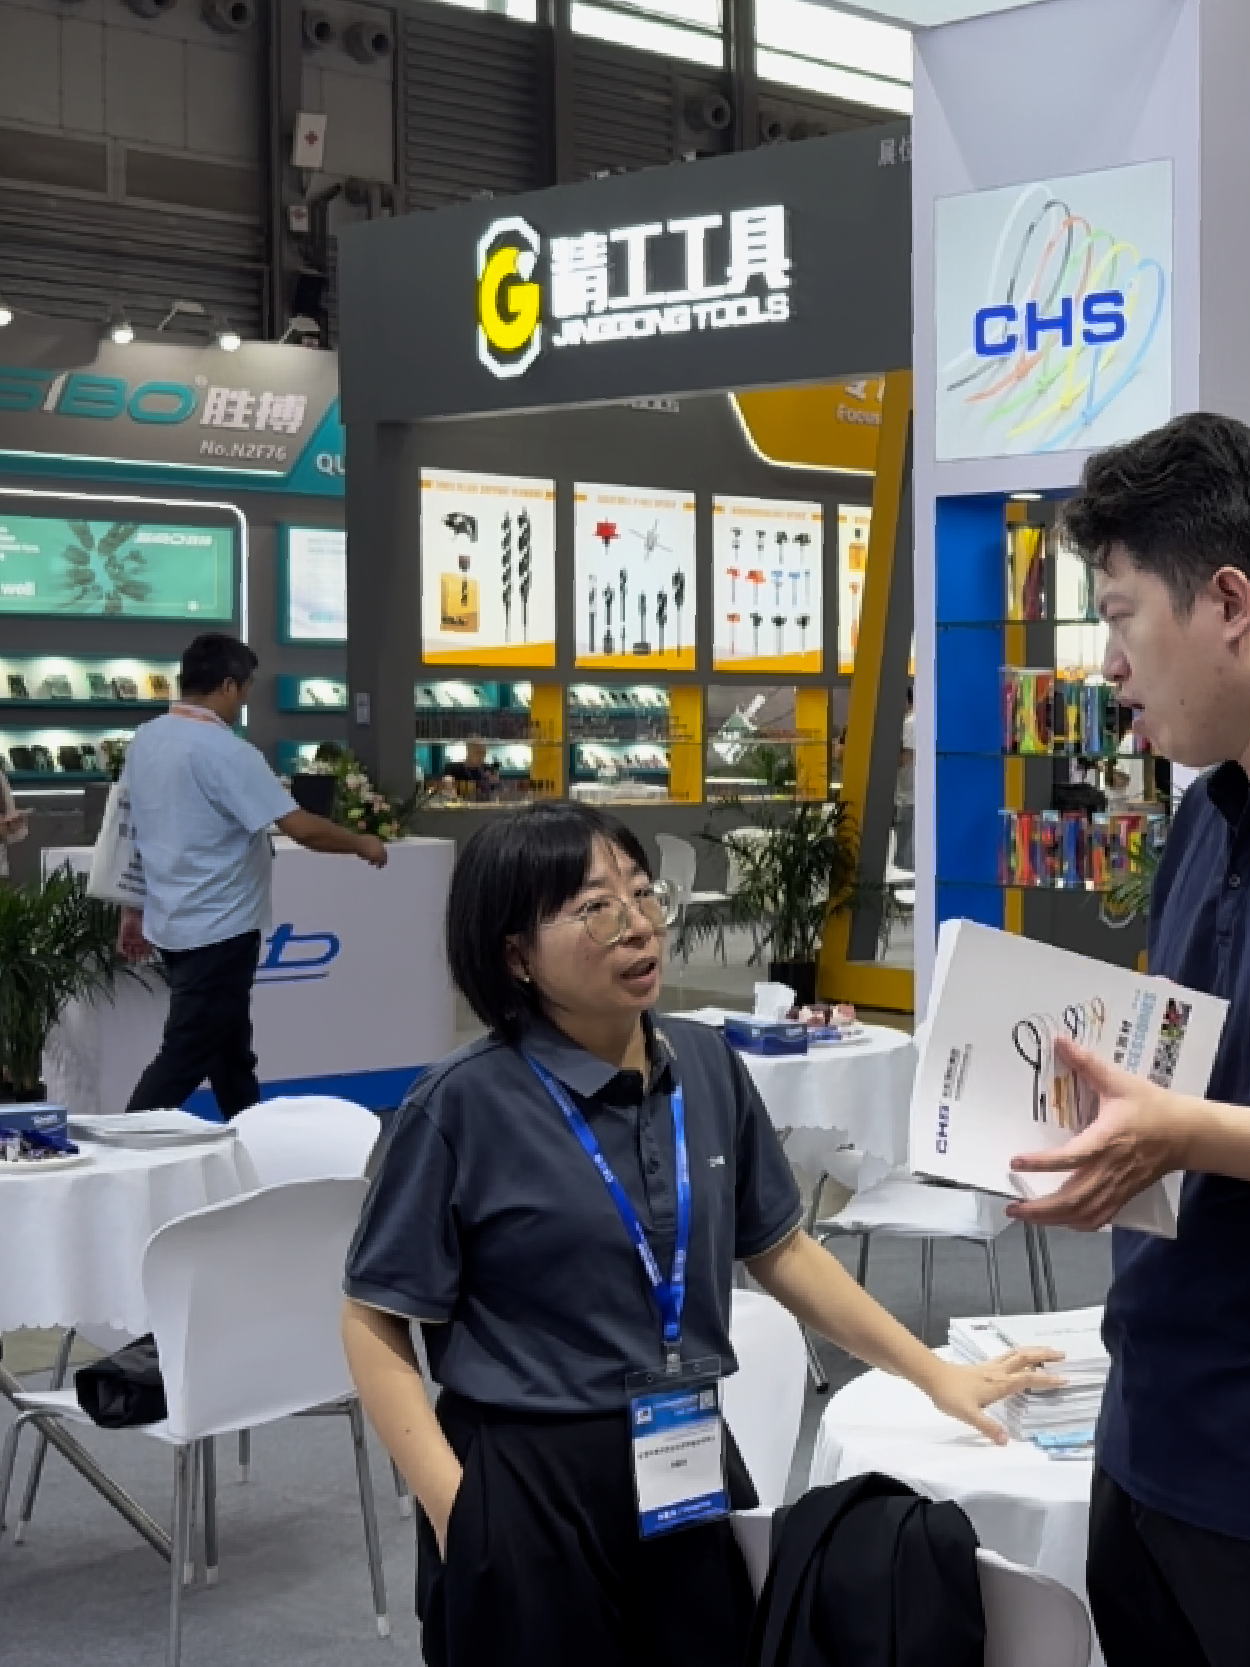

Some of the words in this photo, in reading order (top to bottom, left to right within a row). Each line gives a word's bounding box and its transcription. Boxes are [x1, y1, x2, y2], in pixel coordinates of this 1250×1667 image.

[550, 204, 791, 314] 精工工具
[552, 304, 691, 347] JINGGONG
[691, 293, 790, 331] TOOLS
[972, 289, 1127, 358] CHS
[200, 385, 308, 435] 胜博
